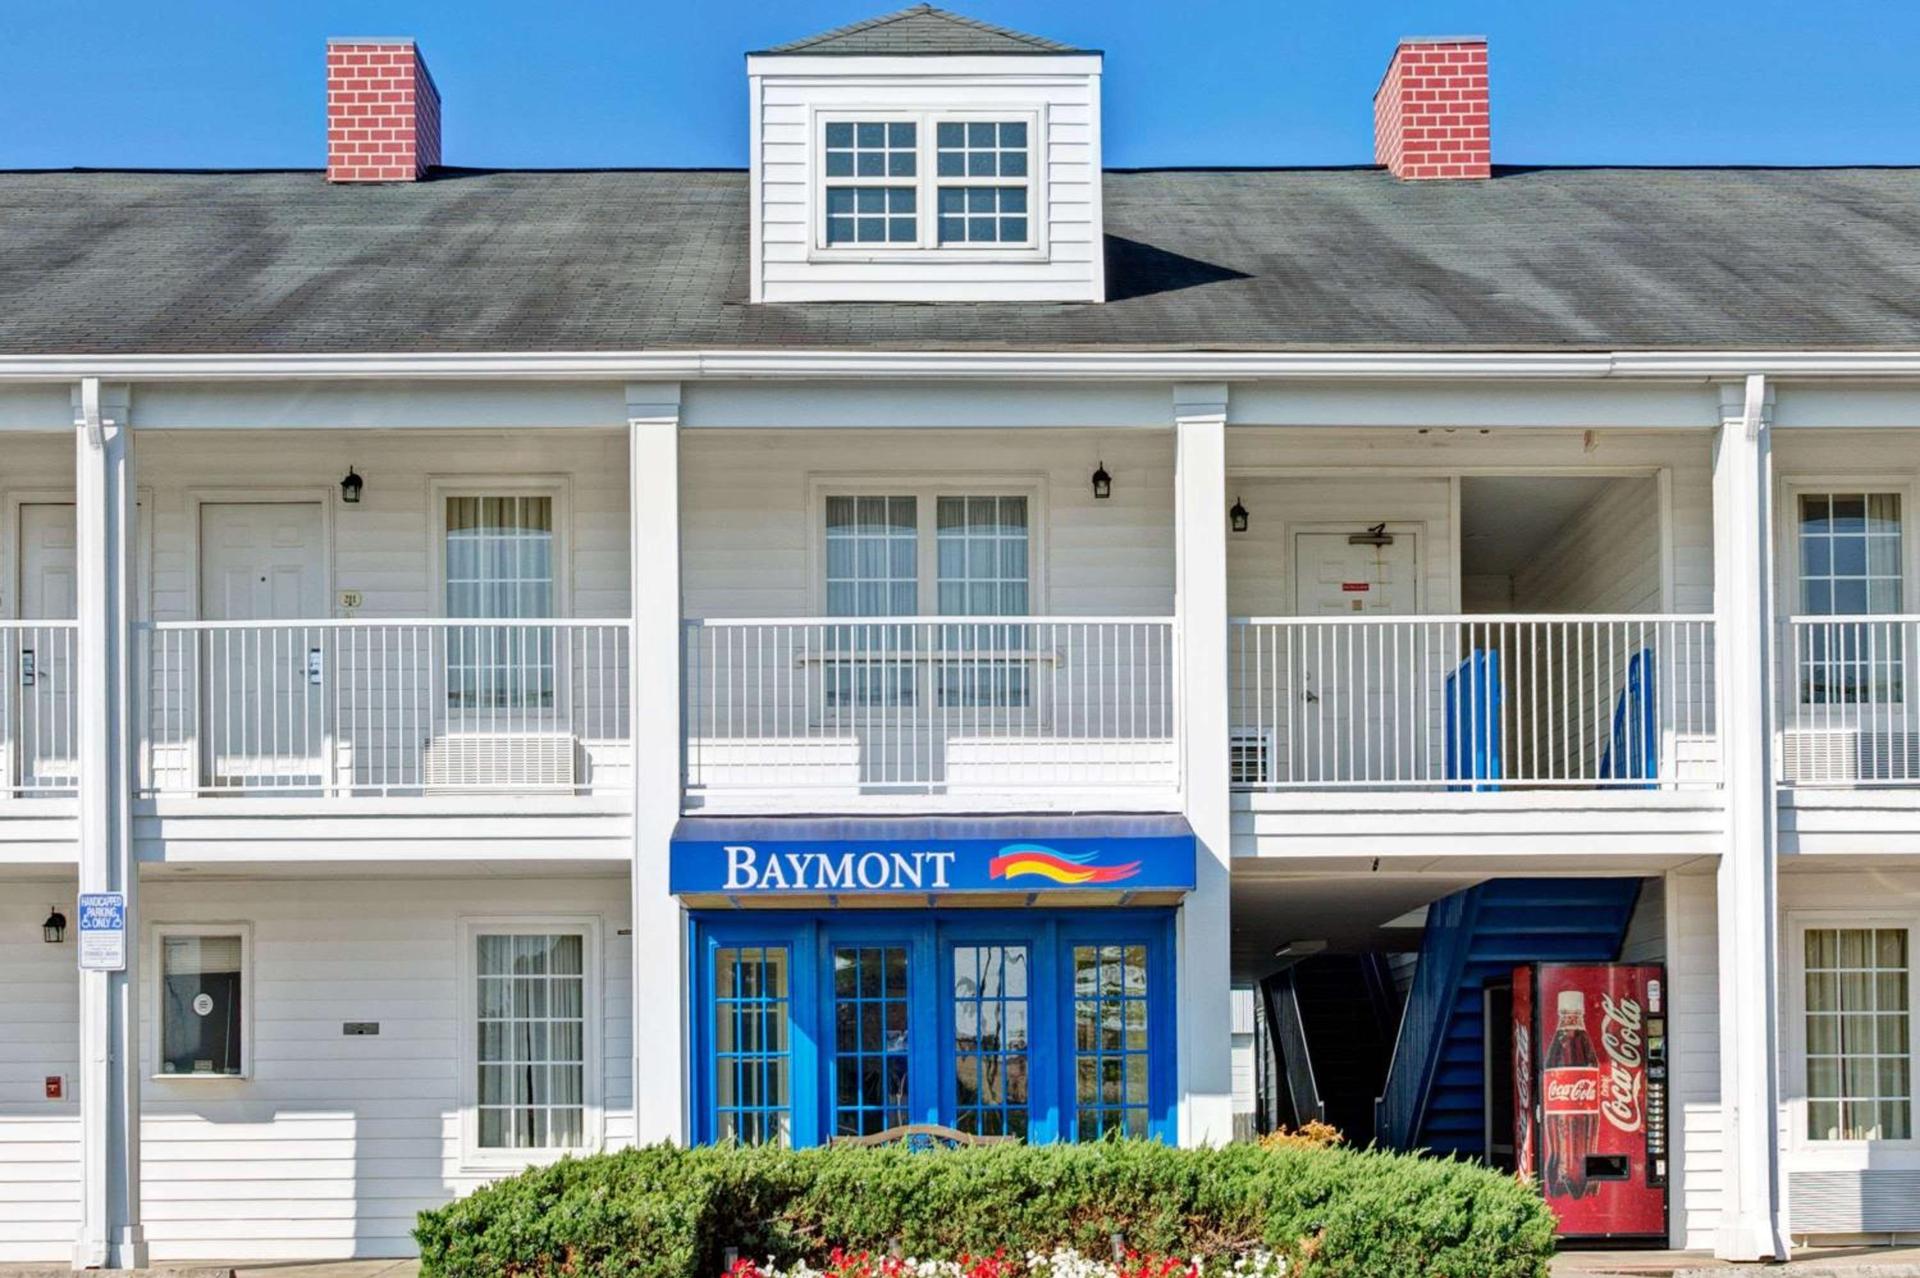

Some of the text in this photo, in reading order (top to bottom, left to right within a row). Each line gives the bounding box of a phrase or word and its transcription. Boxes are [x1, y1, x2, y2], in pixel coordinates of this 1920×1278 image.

[722, 846, 956, 889] BAYMONT
[81, 896, 122, 906] HANDICAPPED
[86, 907, 117, 918] PARKING
[92, 917, 112, 928] ONLY
